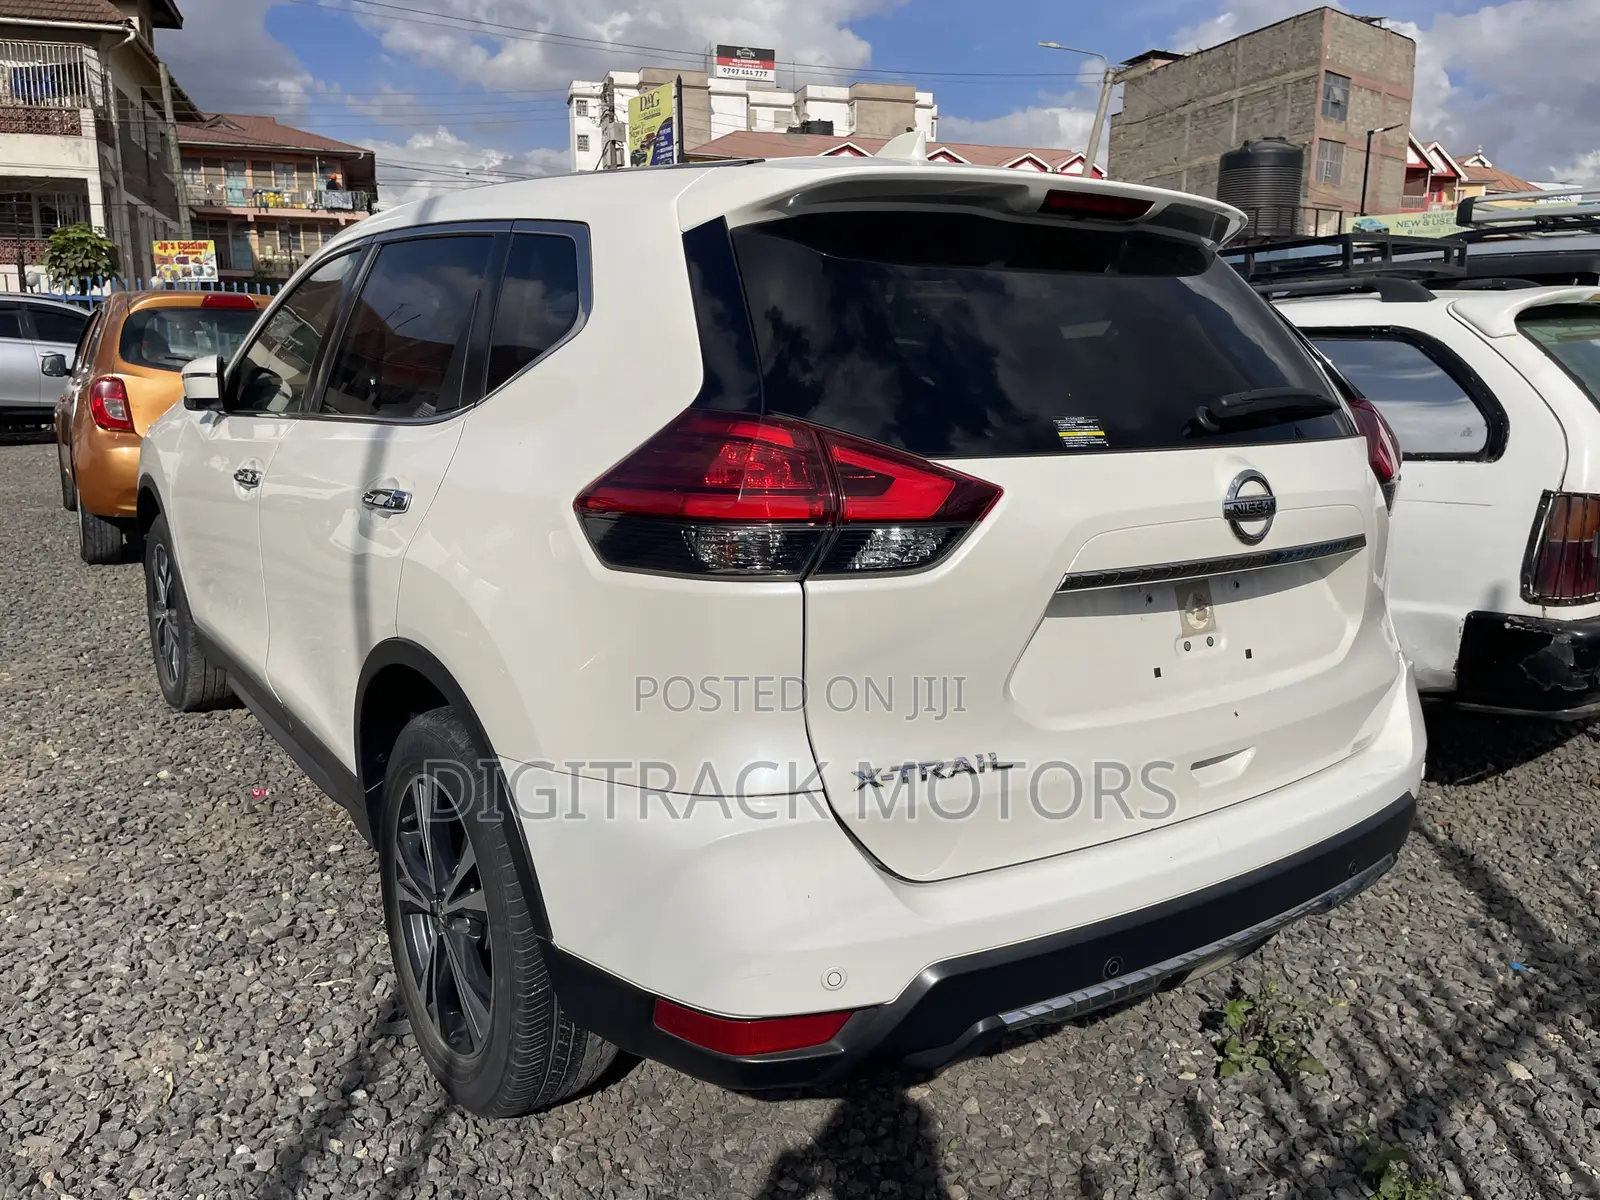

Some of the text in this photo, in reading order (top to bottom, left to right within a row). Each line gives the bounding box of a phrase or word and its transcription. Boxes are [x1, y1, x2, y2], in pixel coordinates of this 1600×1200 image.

[723, 67, 740, 75] 0707
[1396, 220, 1419, 228] NEW
[1233, 501, 1275, 515] NISSAN
[851, 752, 1015, 792] X-TRAIL
